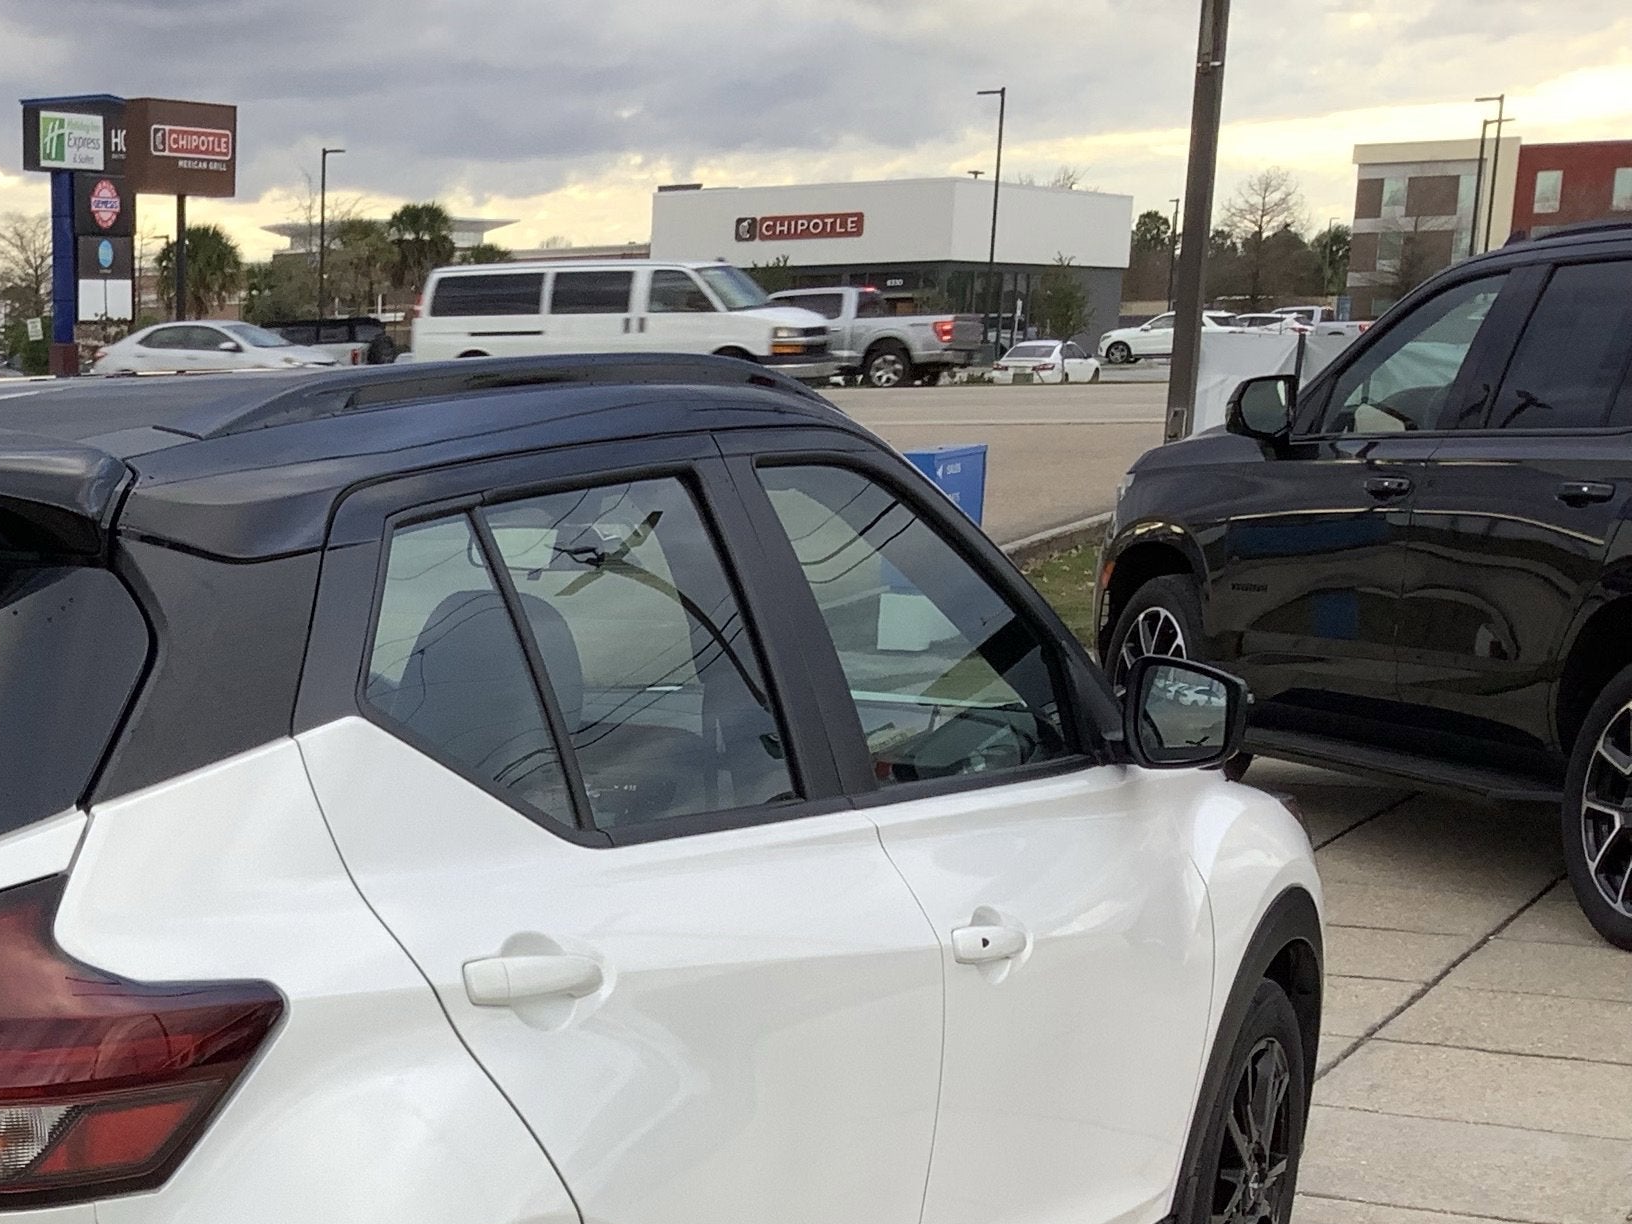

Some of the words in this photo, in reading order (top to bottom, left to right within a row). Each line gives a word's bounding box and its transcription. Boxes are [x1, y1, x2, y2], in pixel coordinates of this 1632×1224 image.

[68, 131, 101, 151] Express
[170, 133, 228, 153] CHIPOTLE
[761, 216, 858, 236] CHIPOTLE
